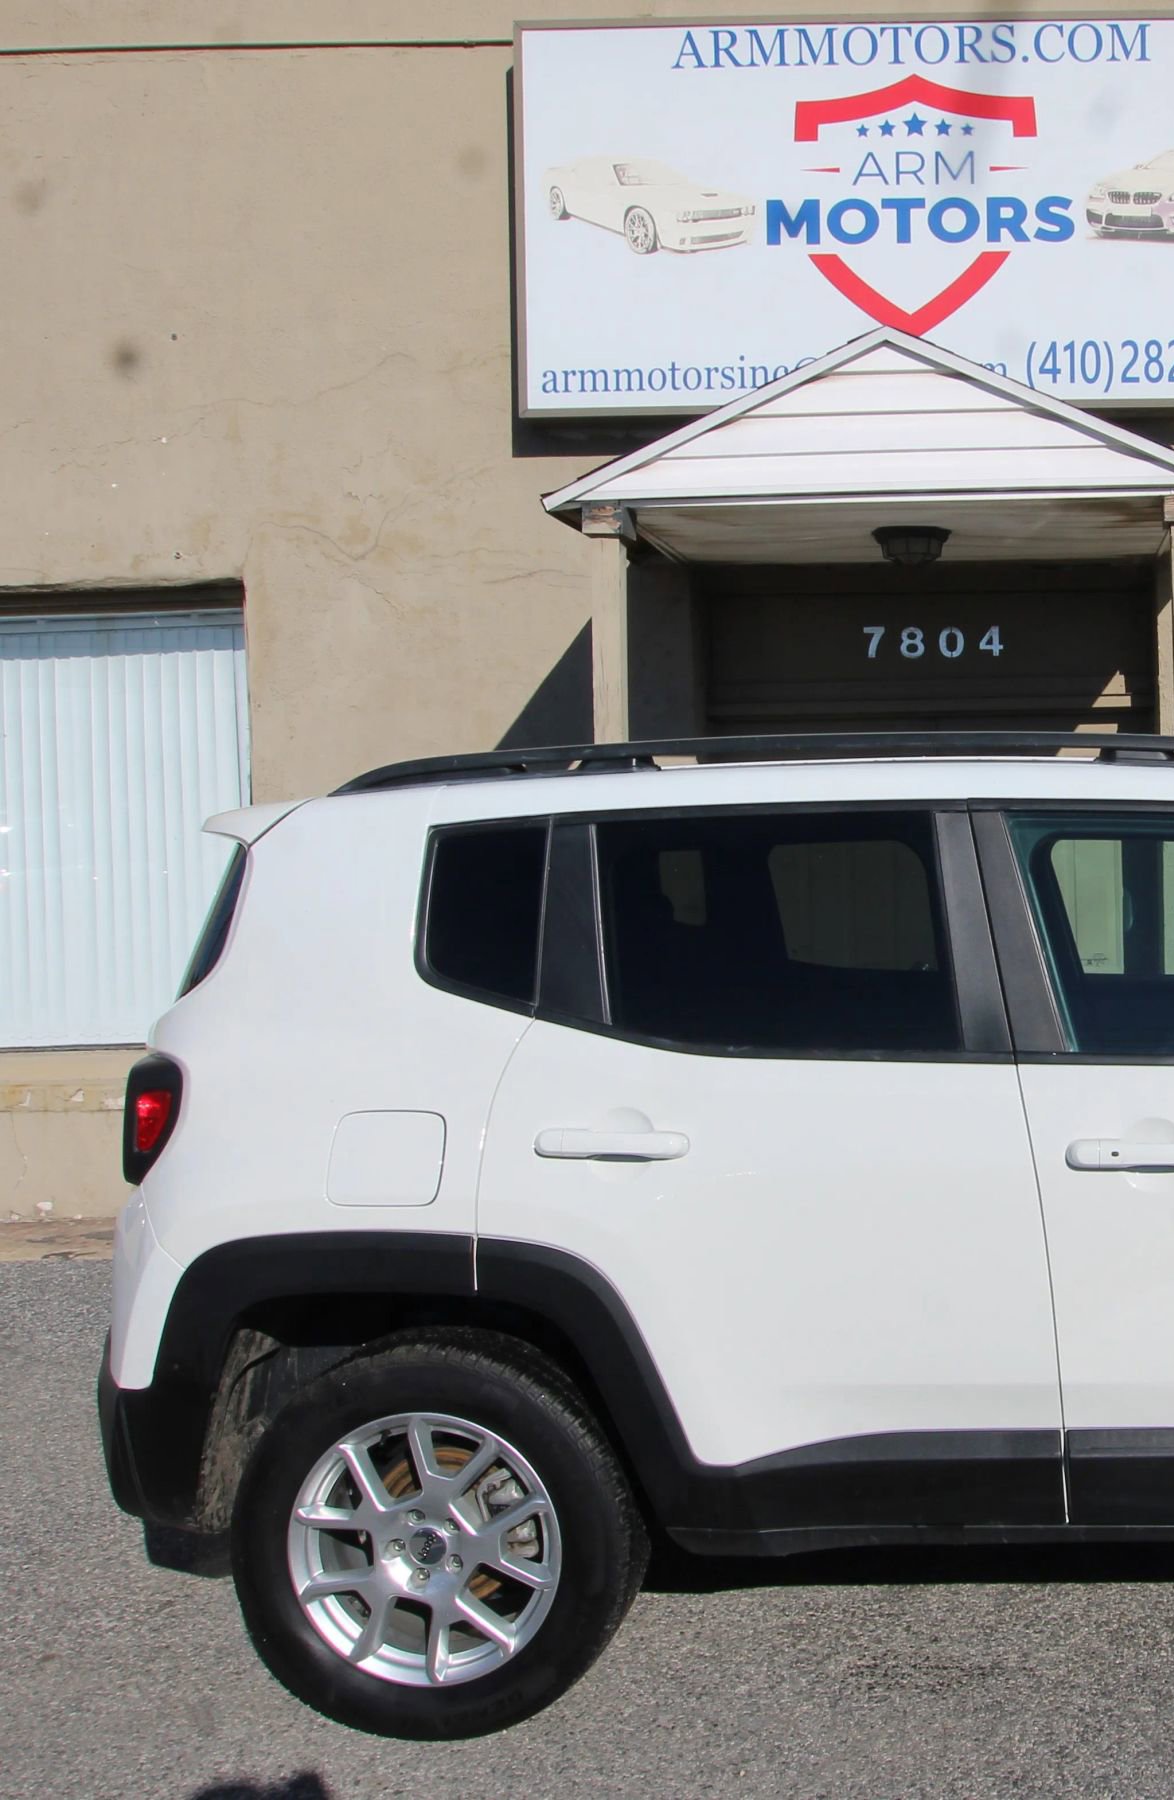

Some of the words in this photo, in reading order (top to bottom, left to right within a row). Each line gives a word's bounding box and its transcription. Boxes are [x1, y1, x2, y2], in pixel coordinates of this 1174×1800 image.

[671, 23, 1152, 69] ARMMOTORS.COM
[852, 150, 975, 185] ARM
[765, 195, 1076, 246] MOTORS
[863, 625, 1004, 659] 7804
